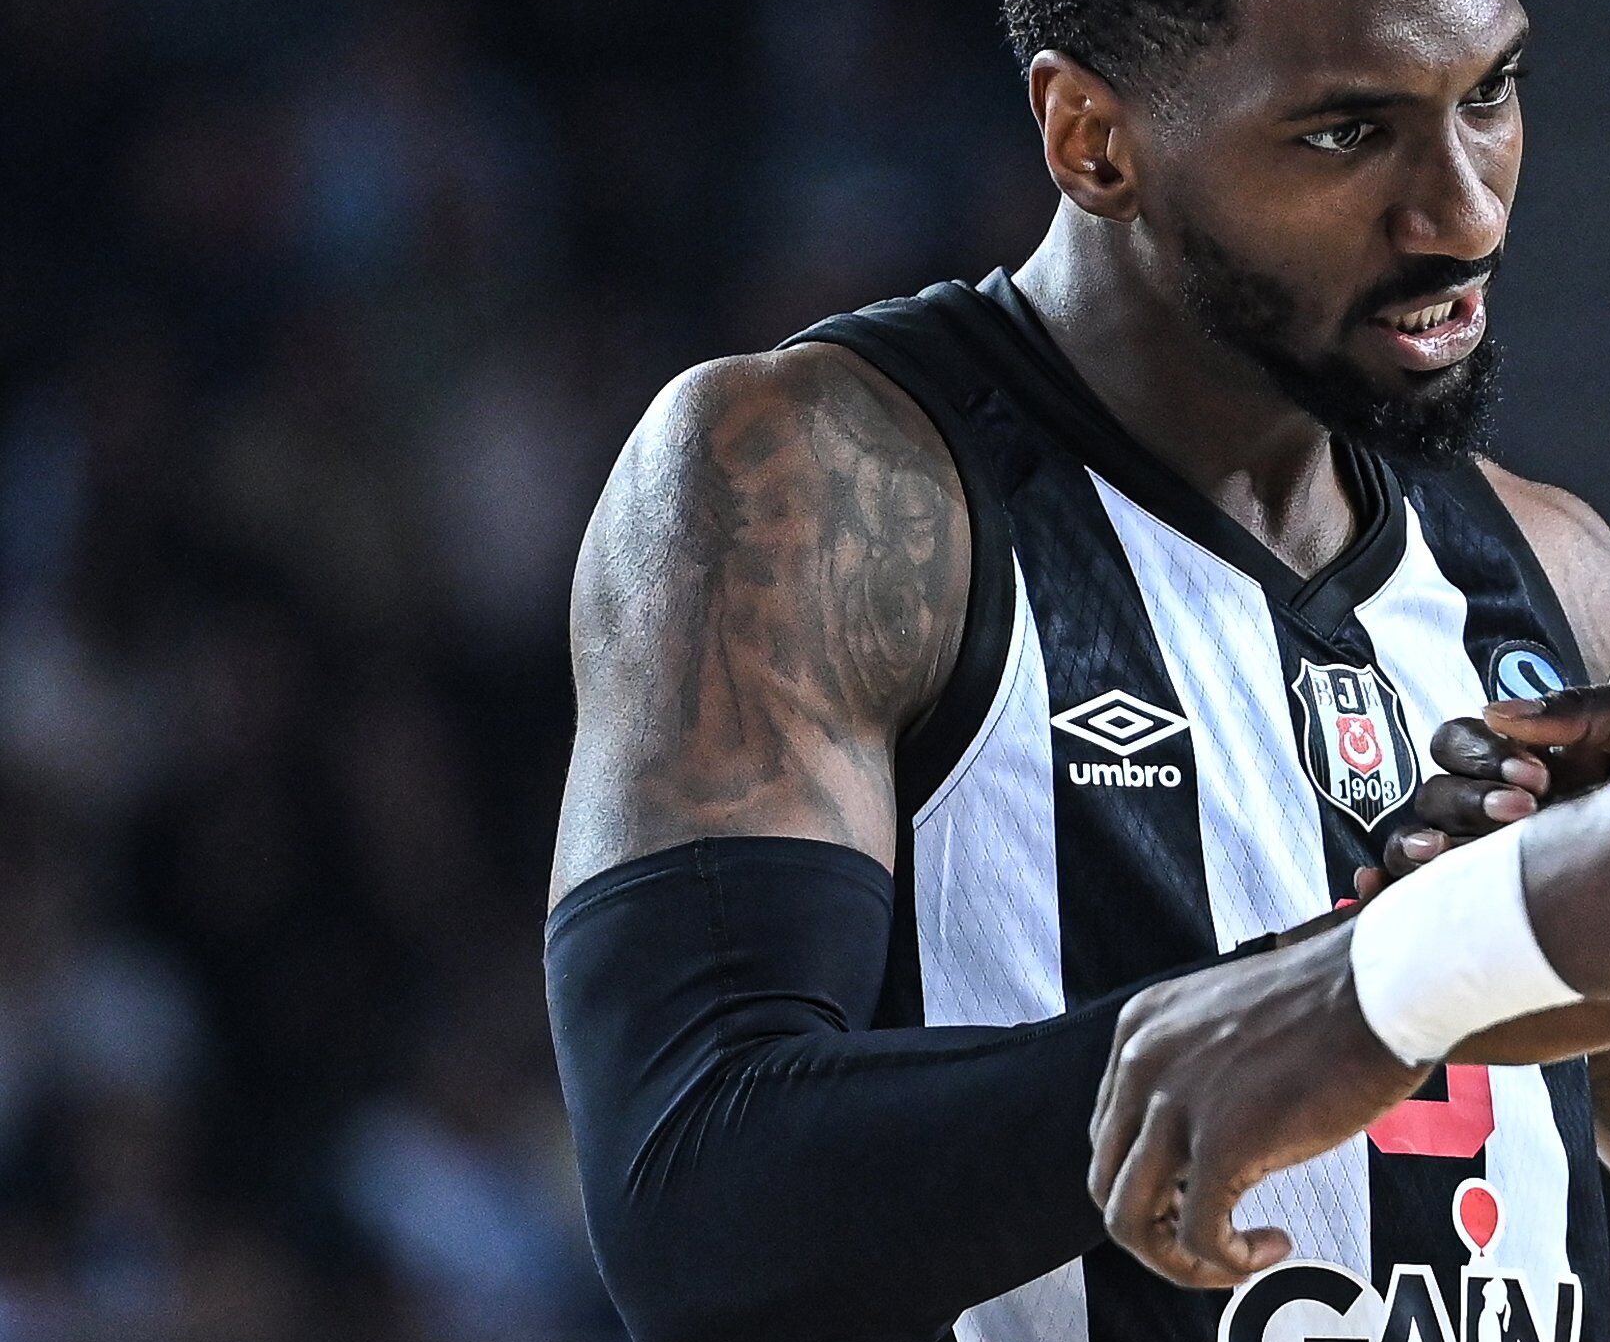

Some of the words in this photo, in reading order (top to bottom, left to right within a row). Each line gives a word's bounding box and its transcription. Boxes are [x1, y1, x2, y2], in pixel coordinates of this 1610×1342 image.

[1313, 677, 1379, 710] BJK
[1068, 757, 1182, 788] umbro
[1338, 777, 1397, 801] 1903
